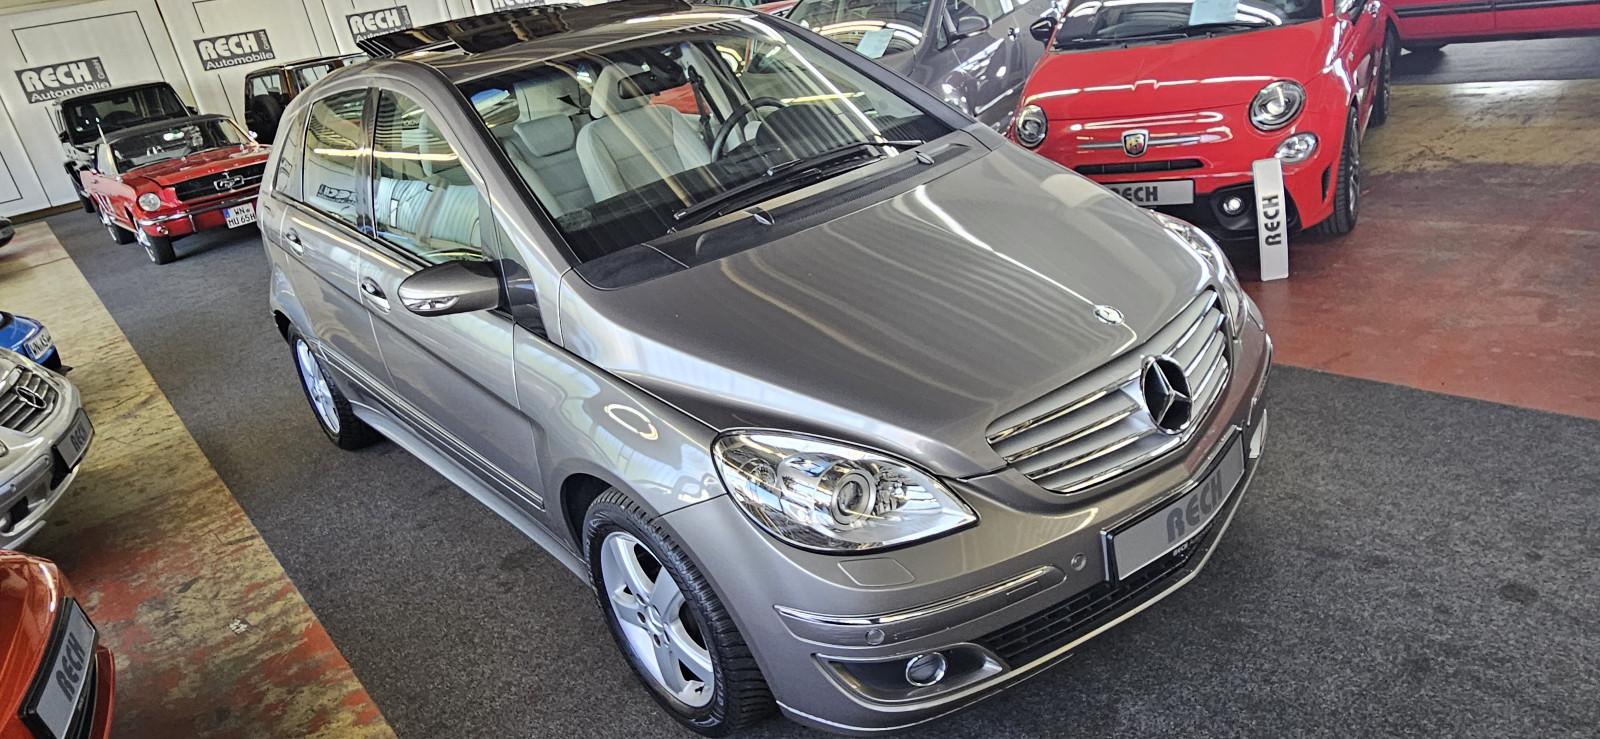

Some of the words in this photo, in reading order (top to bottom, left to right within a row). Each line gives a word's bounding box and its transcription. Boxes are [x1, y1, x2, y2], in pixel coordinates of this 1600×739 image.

[350, 9, 401, 34] RECH
[199, 33, 259, 60] RECH
[206, 52, 274, 70] Automobile
[21, 61, 93, 92] RECH
[31, 81, 110, 102] Automobile
[1262, 194, 1282, 247] RECH
[70, 420, 88, 452] RECH
[1166, 470, 1223, 544] RECH
[56, 631, 86, 703] RECH
